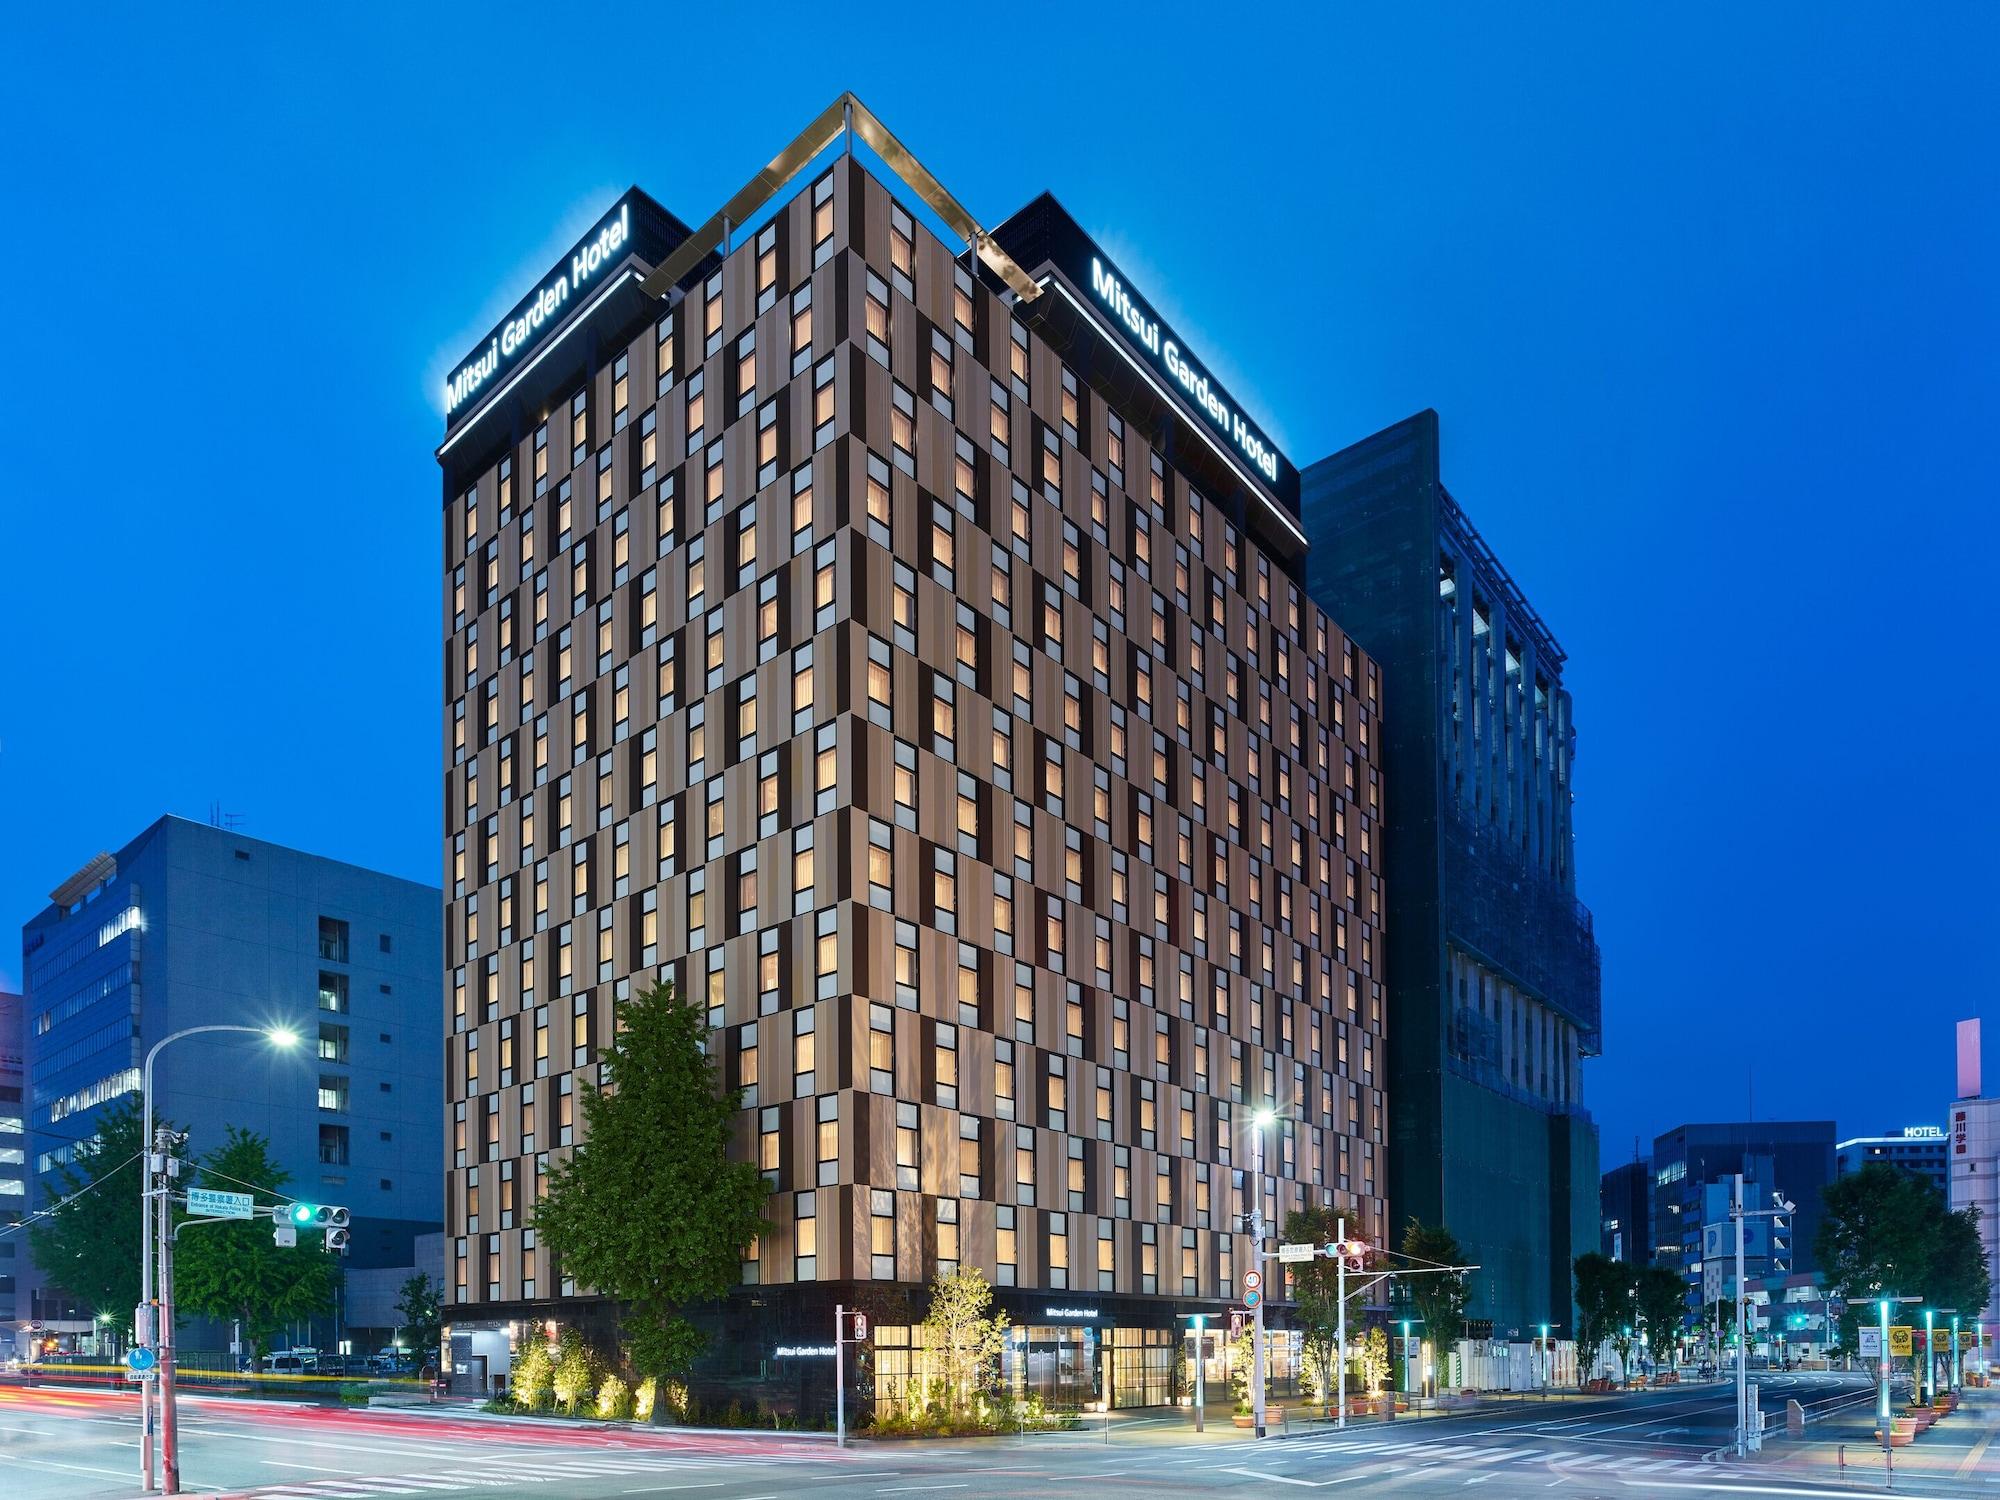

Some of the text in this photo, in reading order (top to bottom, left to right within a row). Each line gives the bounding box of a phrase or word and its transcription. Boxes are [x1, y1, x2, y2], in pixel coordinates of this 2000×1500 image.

[447, 203, 629, 414] Mitsui Garden Hotel
[1092, 257, 1278, 483] Mitsui Garden Hotel
[1904, 1127, 1944, 1137] HOTEL
[1046, 1307, 1098, 1318] Mitsui Garden Hotel
[777, 1346, 836, 1356] Mitsui Garden Hotel
